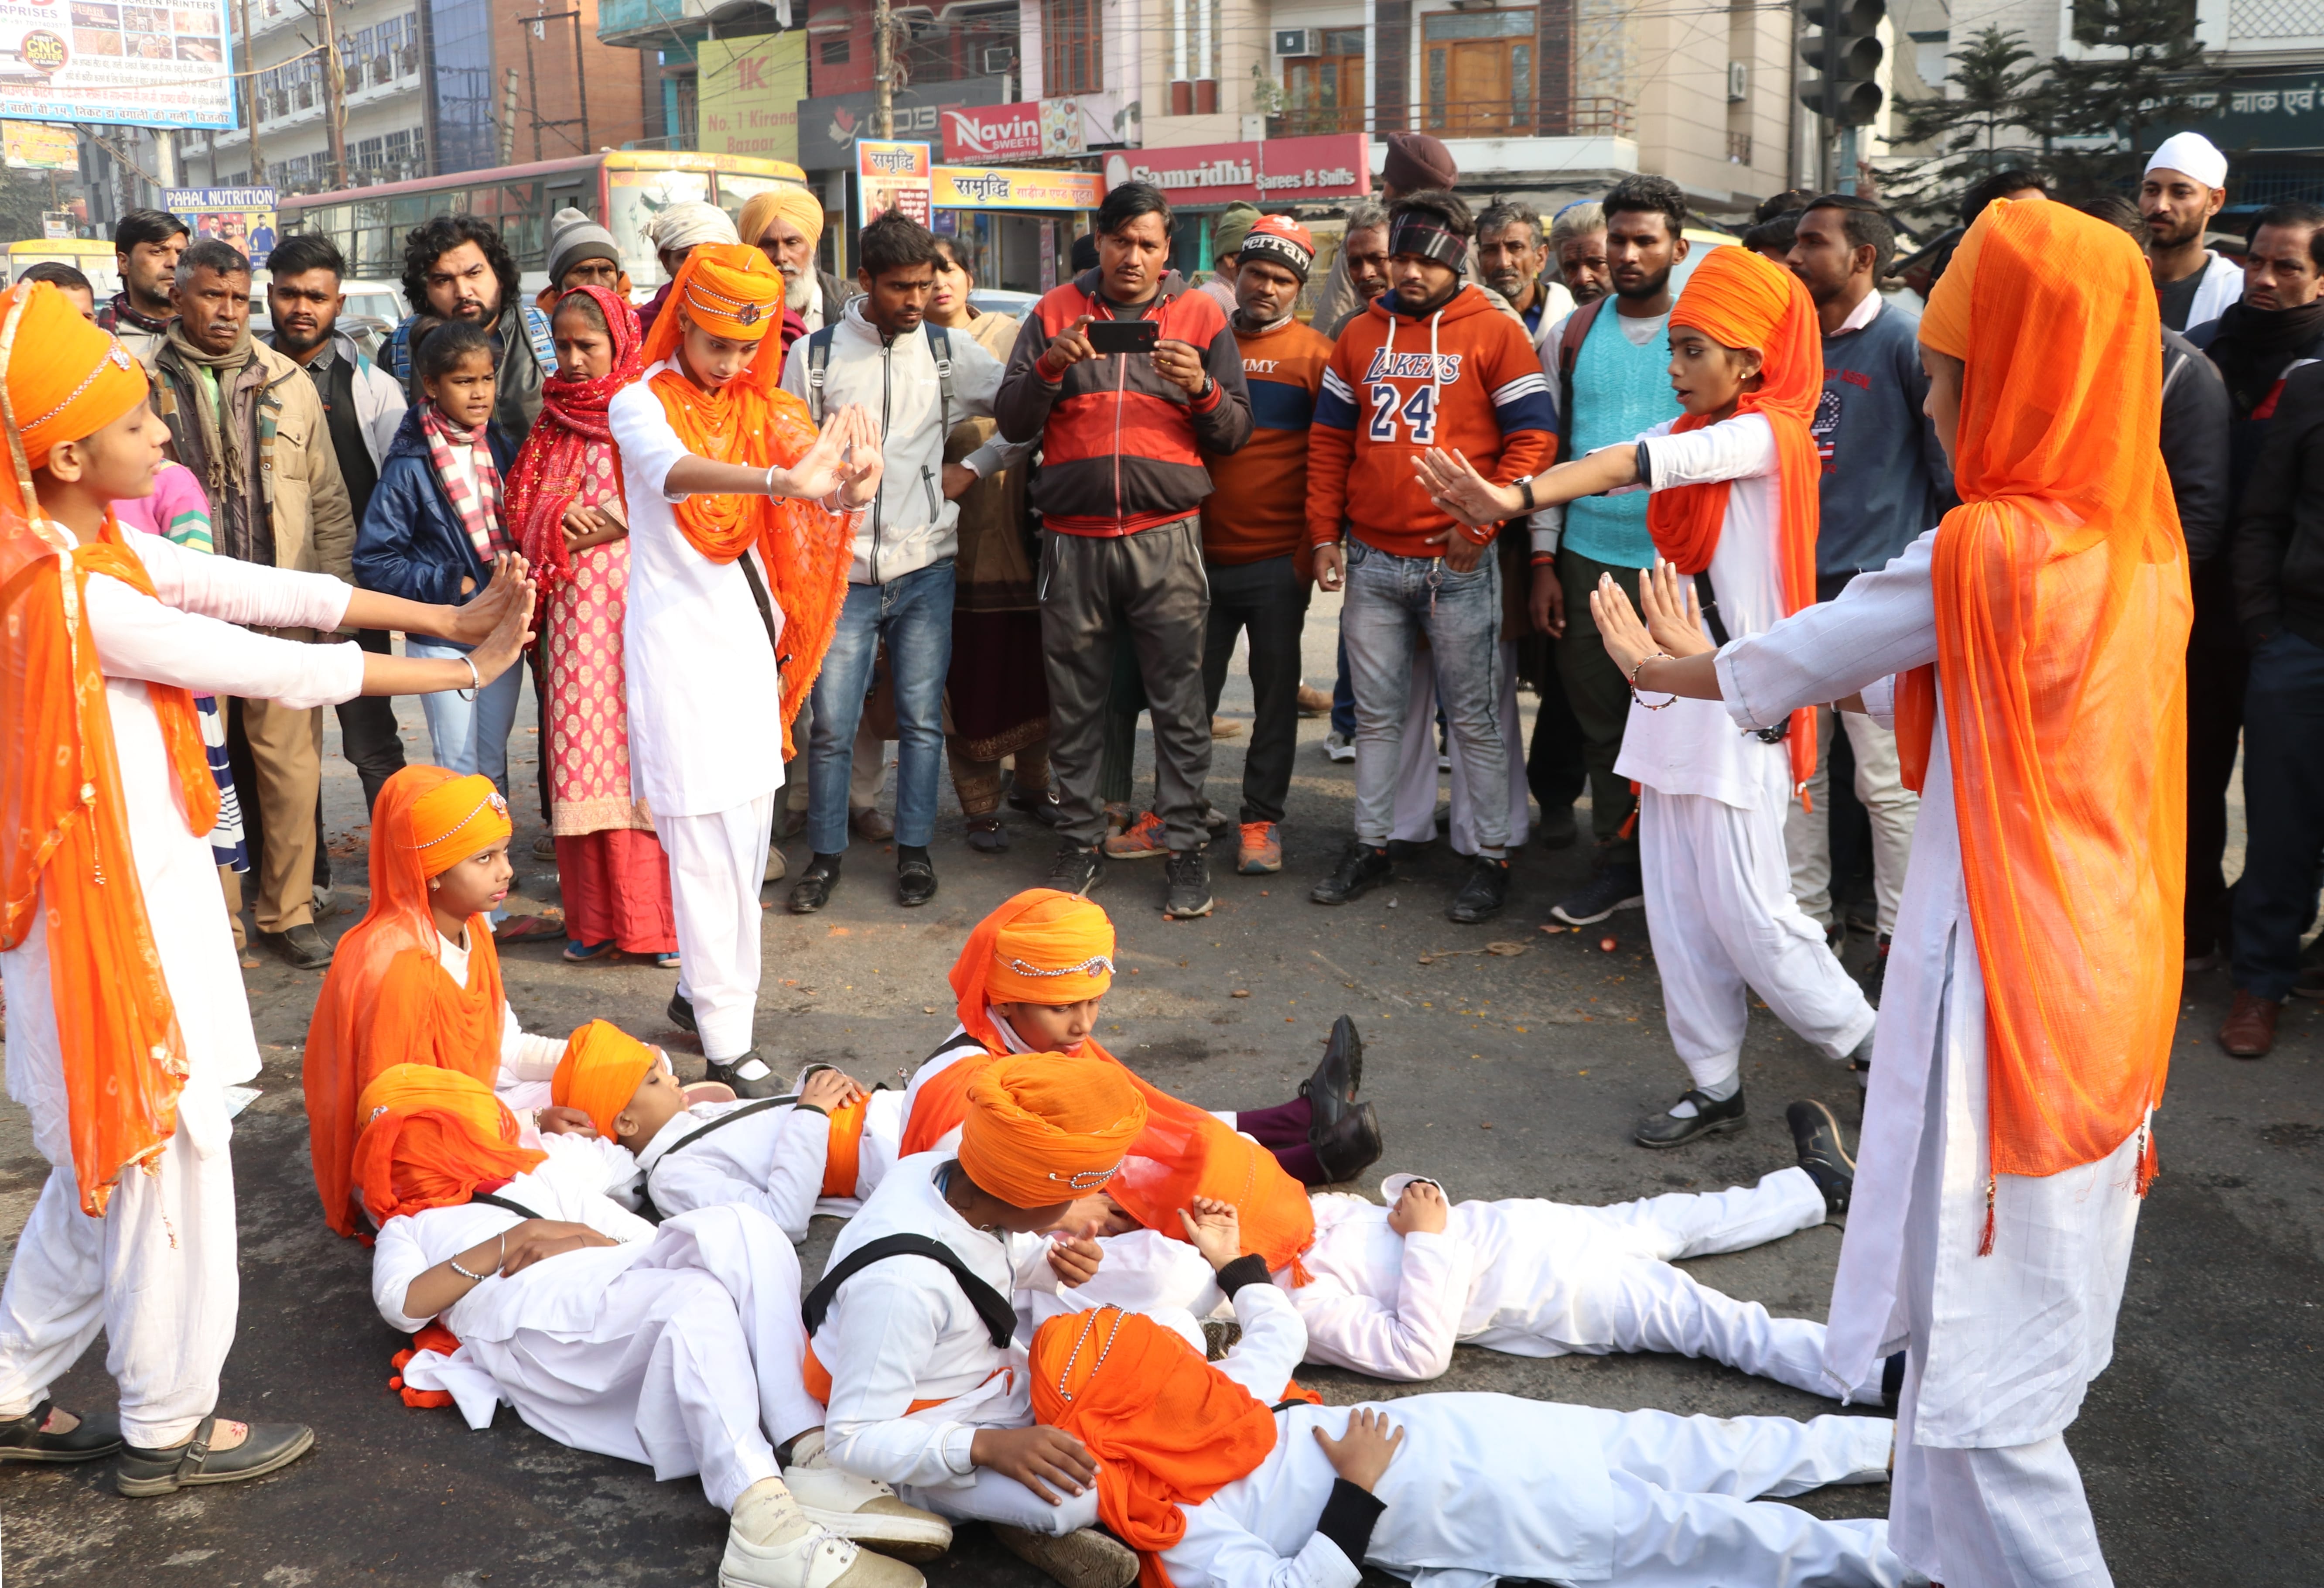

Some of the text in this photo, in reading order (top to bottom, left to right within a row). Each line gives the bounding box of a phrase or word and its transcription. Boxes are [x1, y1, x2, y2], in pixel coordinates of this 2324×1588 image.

[165, 0, 215, 10] PRINTERS
[27, 40, 62, 54] CNC
[27, 51, 63, 60] ROUTER
[736, 56, 769, 91] 1K
[2231, 90, 2279, 113] नाक
[2283, 81, 2317, 116] एवं
[708, 110, 797, 132] No. 1 Kirana
[942, 111, 1039, 153] Navin
[727, 137, 775, 154] Bazaar
[993, 137, 1039, 150] SWEETS
[870, 148, 915, 174] समृद्धि
[1131, 159, 1355, 191] Samridhi Sarees & Suits
[166, 189, 273, 206] PAHAL NUTRITION
[952, 172, 1011, 201] समृद्धि
[1015, 185, 1046, 199] साड़ीज
[1049, 188, 1067, 200] एण्ड
[1362, 346, 1463, 385] LAKERS
[1840, 368, 1872, 390] ASSN.
[1369, 384, 1438, 445] 24
